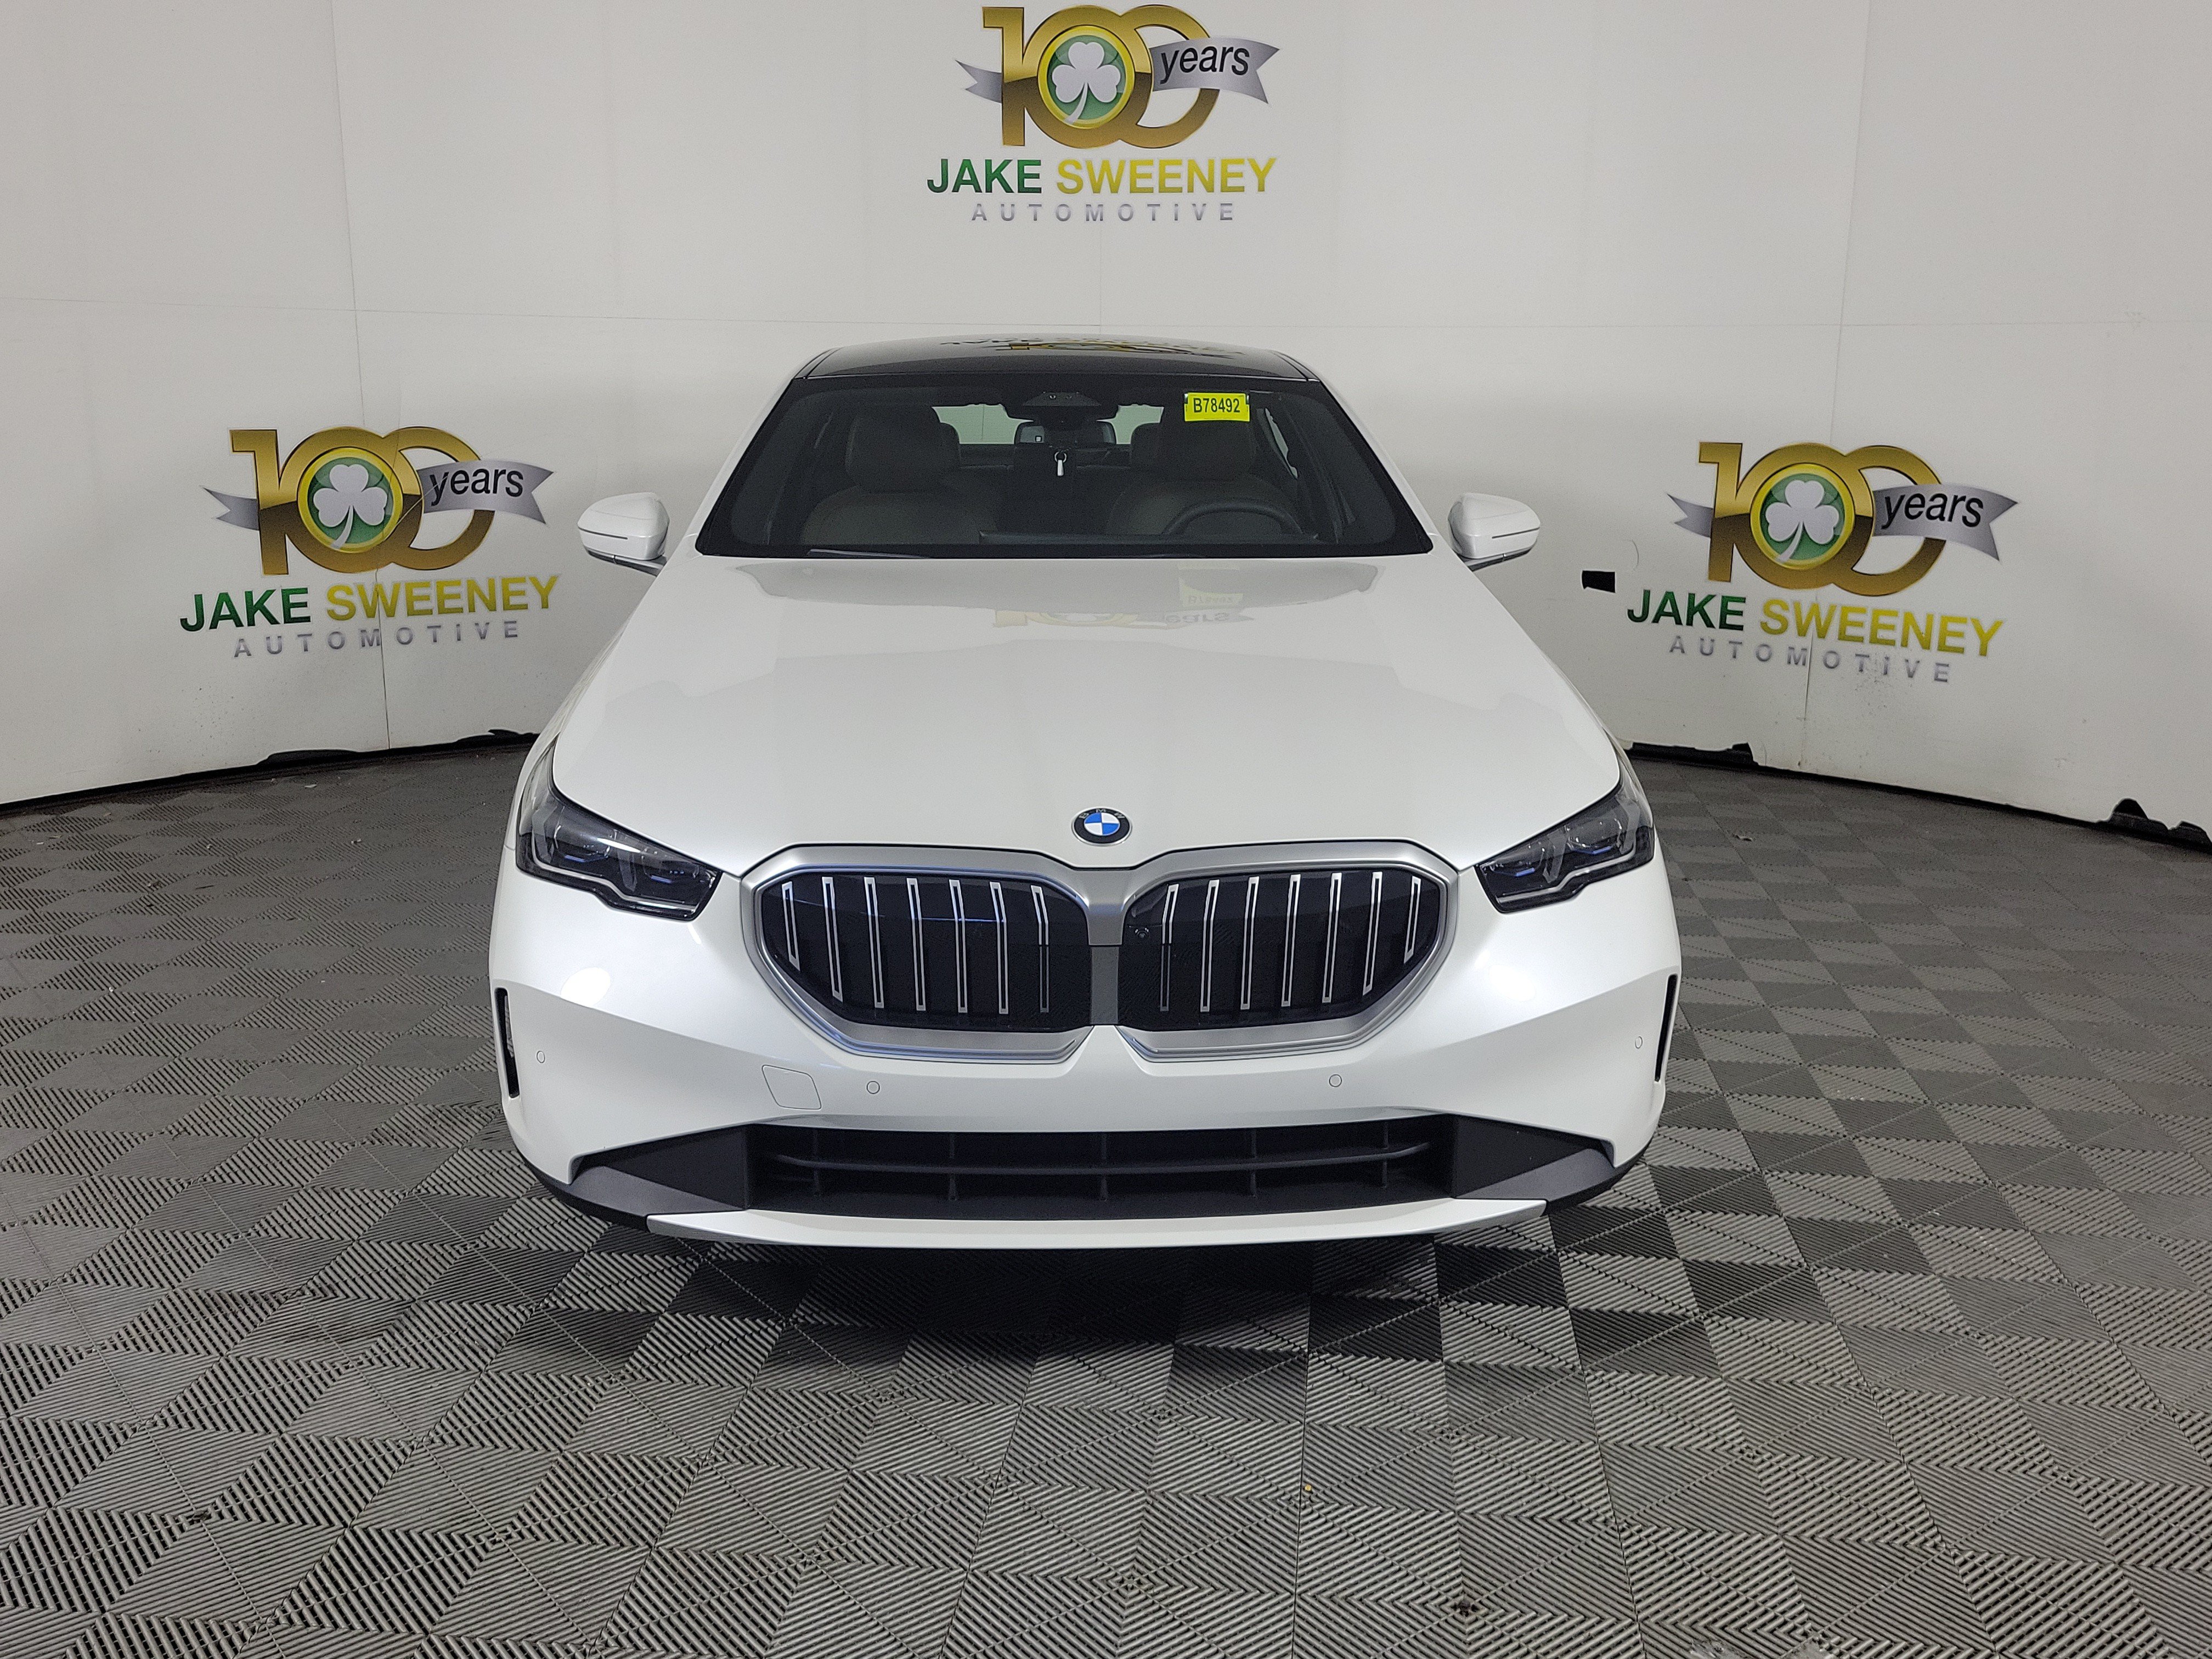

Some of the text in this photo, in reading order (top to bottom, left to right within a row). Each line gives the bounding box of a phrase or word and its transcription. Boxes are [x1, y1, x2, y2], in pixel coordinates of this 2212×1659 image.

[982, 4, 1250, 149] 100 years
[927, 157, 1277, 194] JAKE SWEENEY
[971, 202, 1233, 222] AUTOMOTIVE
[1193, 397, 1240, 413] B78492
[230, 426, 524, 574] 100 years
[1699, 442, 1985, 597] 100 years
[179, 575, 558, 632] JAKE SWEENEY
[1627, 589, 2004, 657] JAKE SWEENEY
[234, 620, 518, 658] AUTOMOTIVE
[1669, 635, 1950, 683] AUTOMOTIVE
[1079, 808, 1125, 819] BMW
